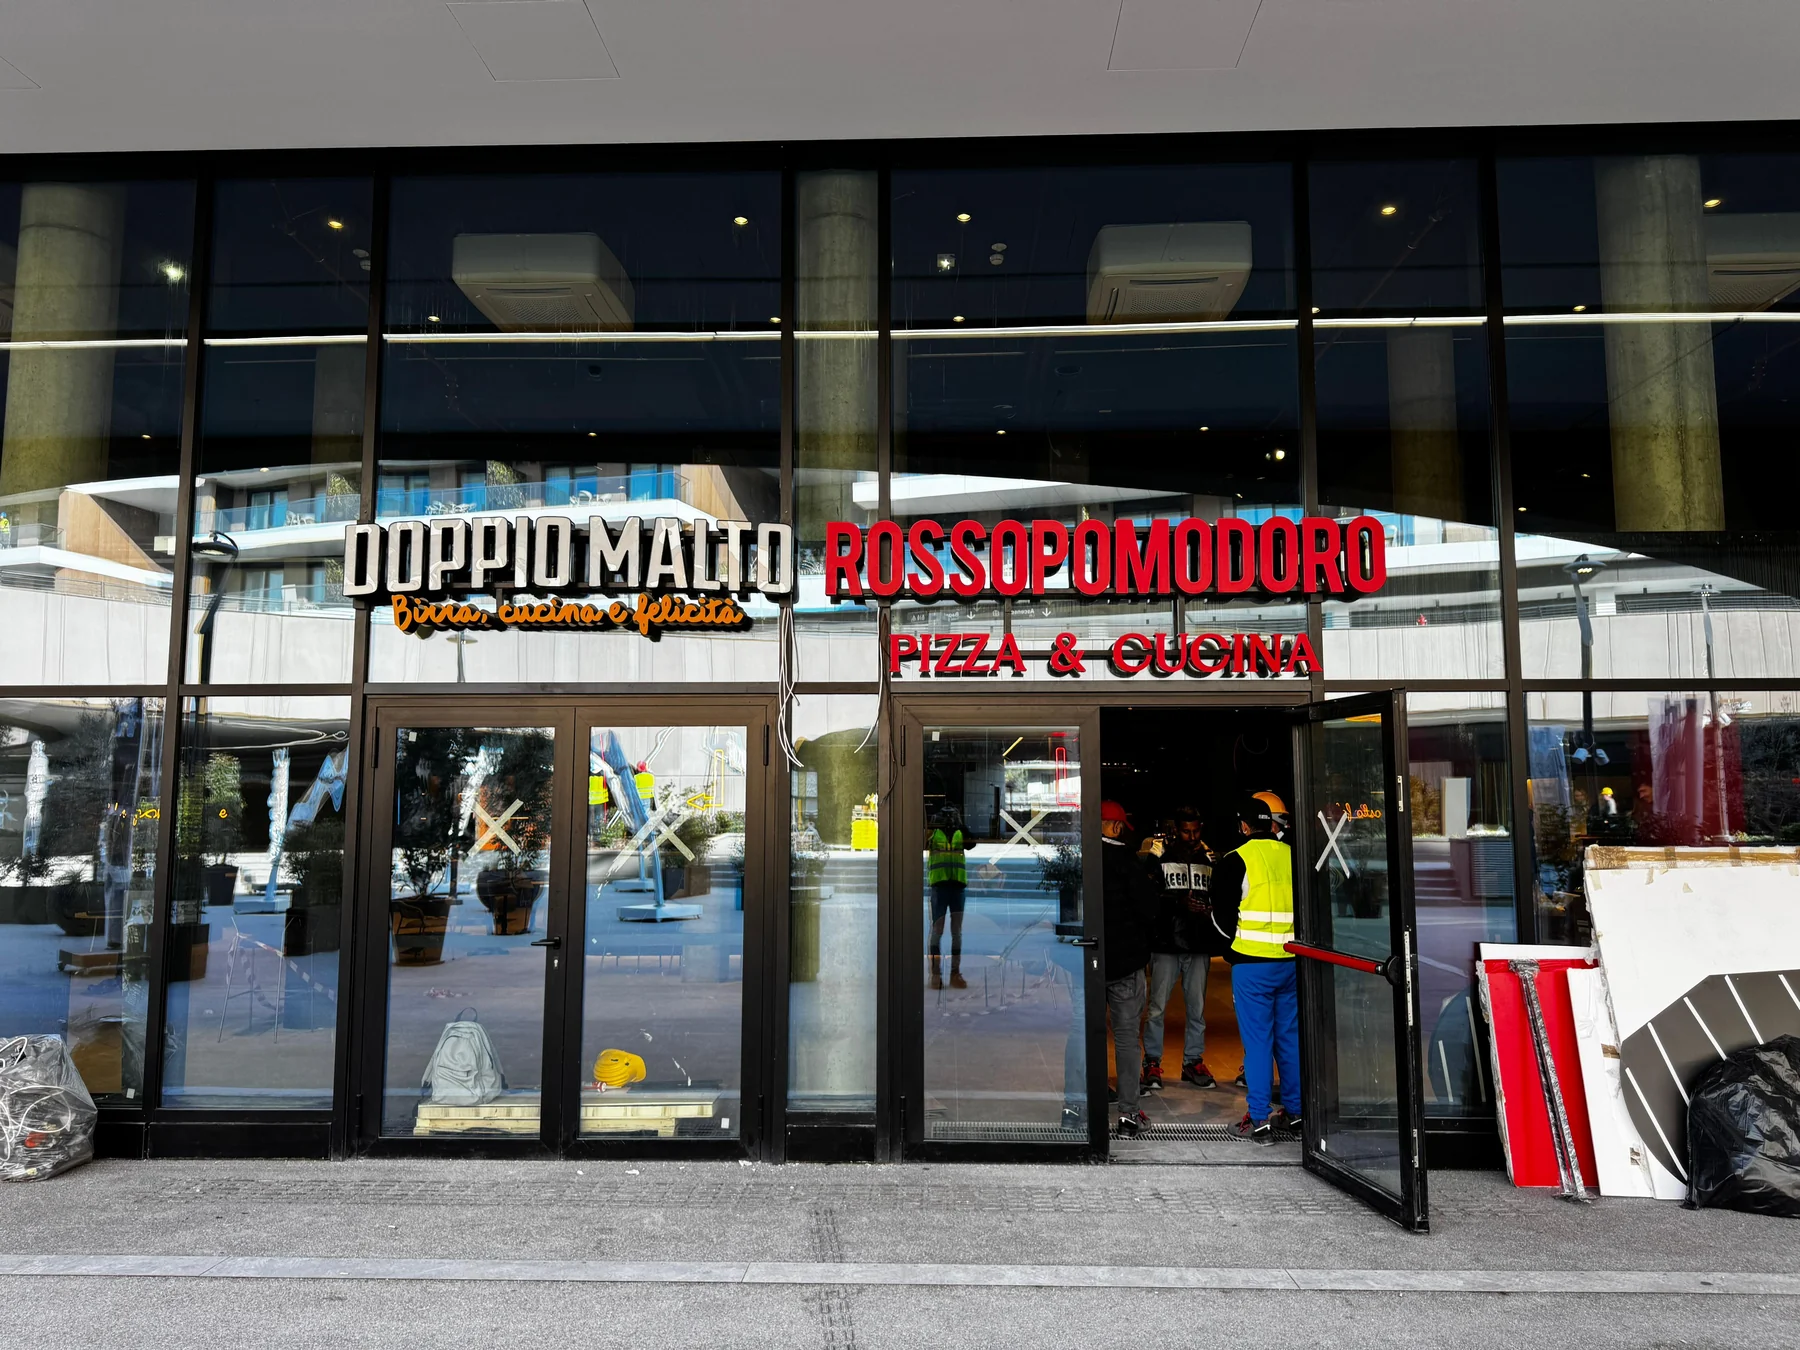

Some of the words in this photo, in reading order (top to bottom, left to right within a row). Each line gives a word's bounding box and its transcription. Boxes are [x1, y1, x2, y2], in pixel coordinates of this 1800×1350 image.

[343, 516, 572, 596] DOPPIO
[589, 516, 793, 594] MALTO
[825, 516, 1387, 597] ROSSOPOMODORO
[392, 594, 488, 632] Birra,
[498, 599, 600, 624] cucina
[609, 601, 626, 621] e
[632, 594, 745, 635] felicità
[889, 632, 1026, 675] PIZZA
[1049, 632, 1088, 675] &
[1112, 630, 1324, 674] CUCINA
